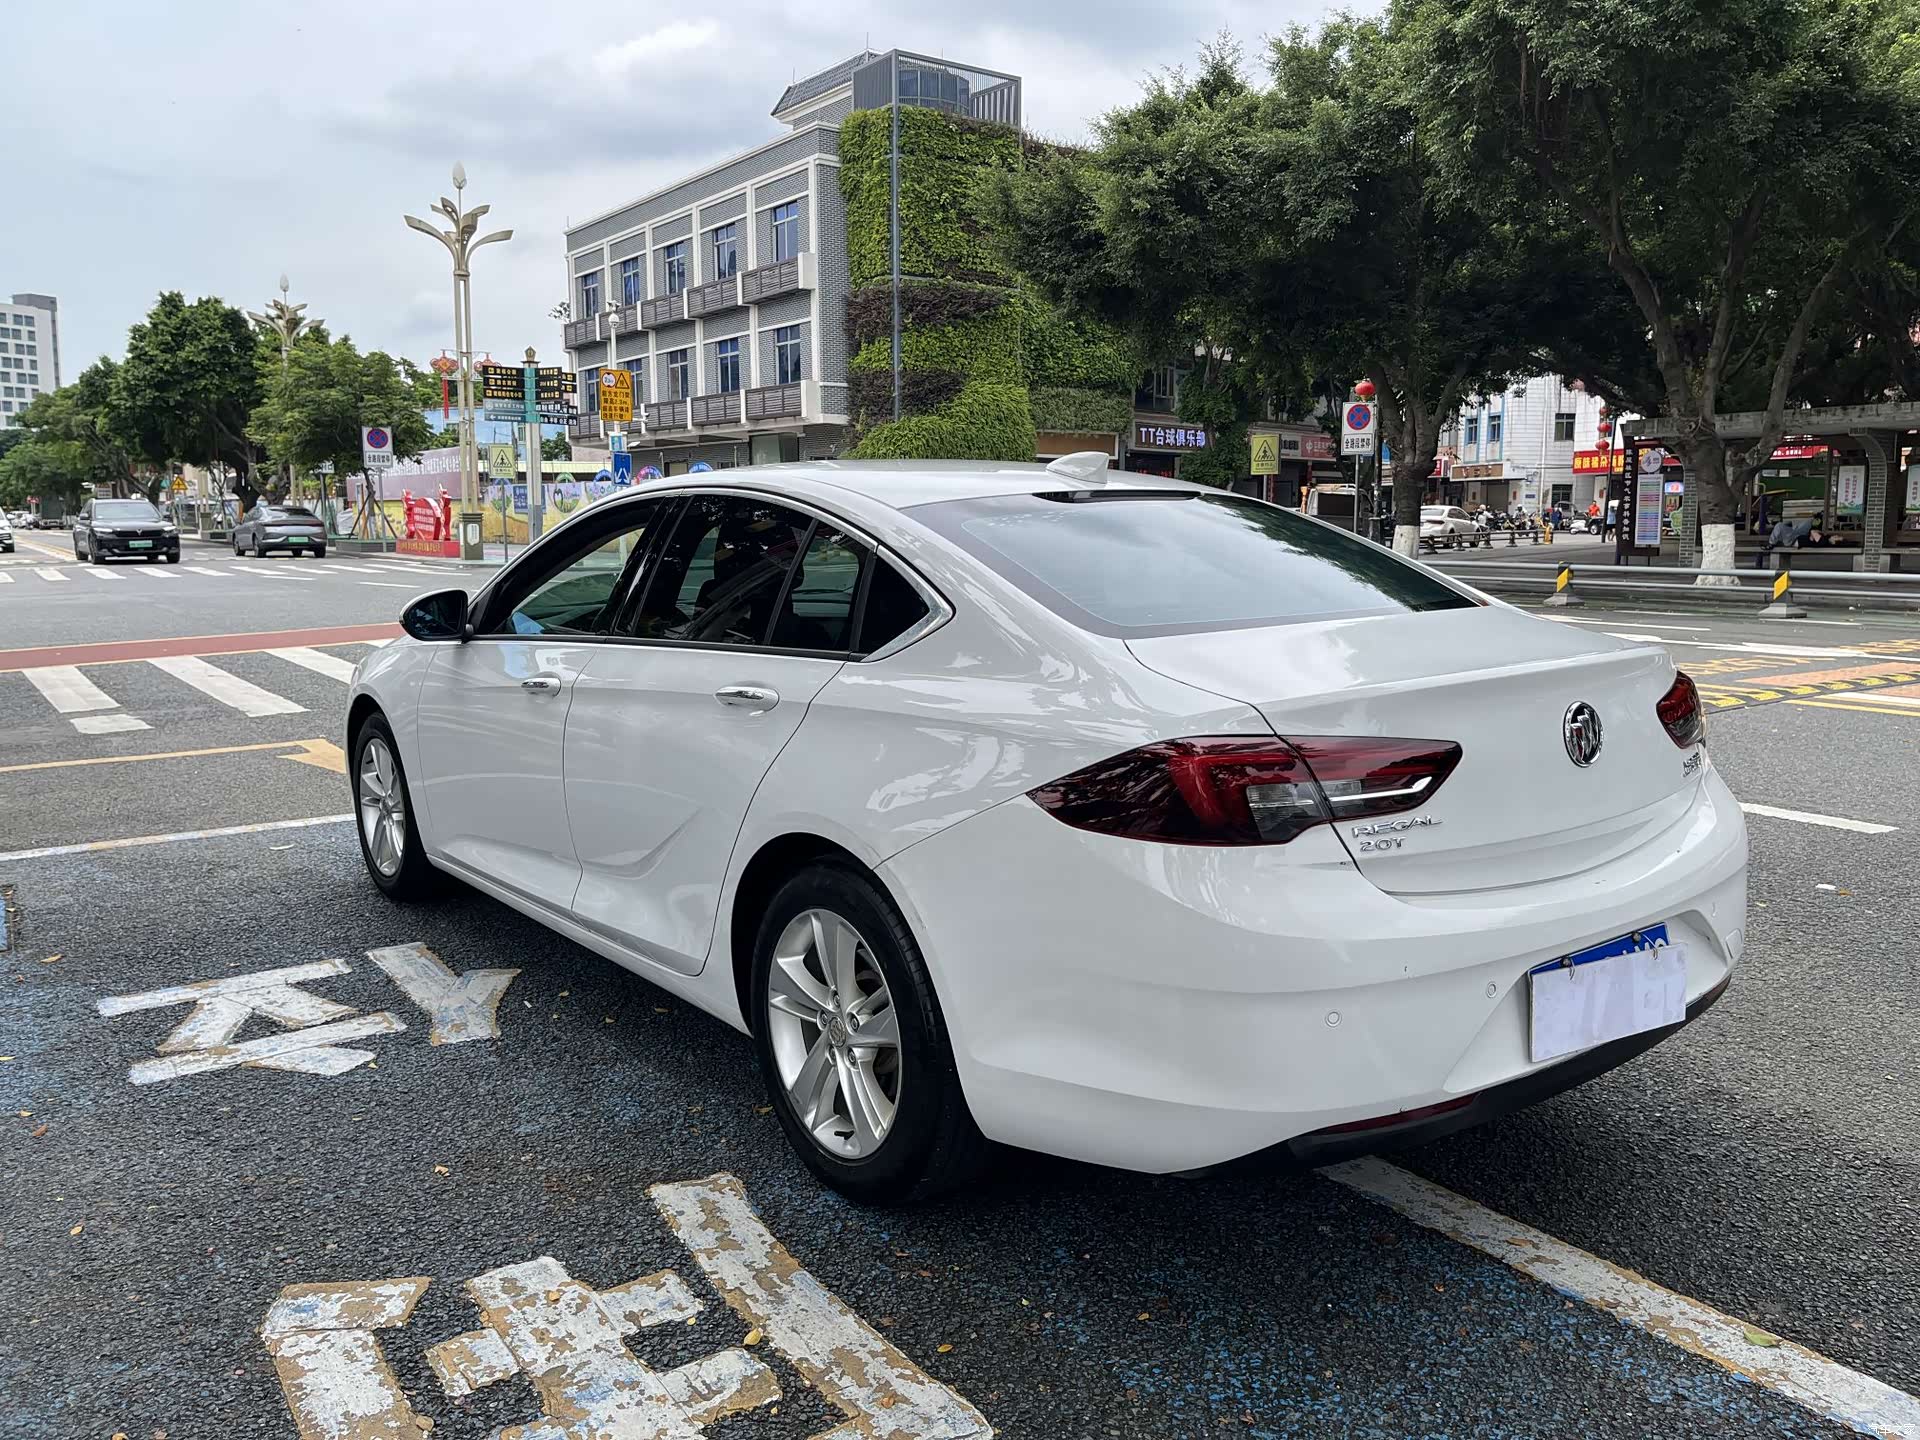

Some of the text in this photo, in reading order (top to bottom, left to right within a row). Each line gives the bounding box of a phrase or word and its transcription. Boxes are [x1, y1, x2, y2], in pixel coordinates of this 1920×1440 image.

[1139, 427, 1206, 448] TT台球俱乐部
[1344, 437, 1371, 449] 全路段禁停
[1352, 815, 1443, 838] REGAL
[1359, 836, 1407, 852] 20T
